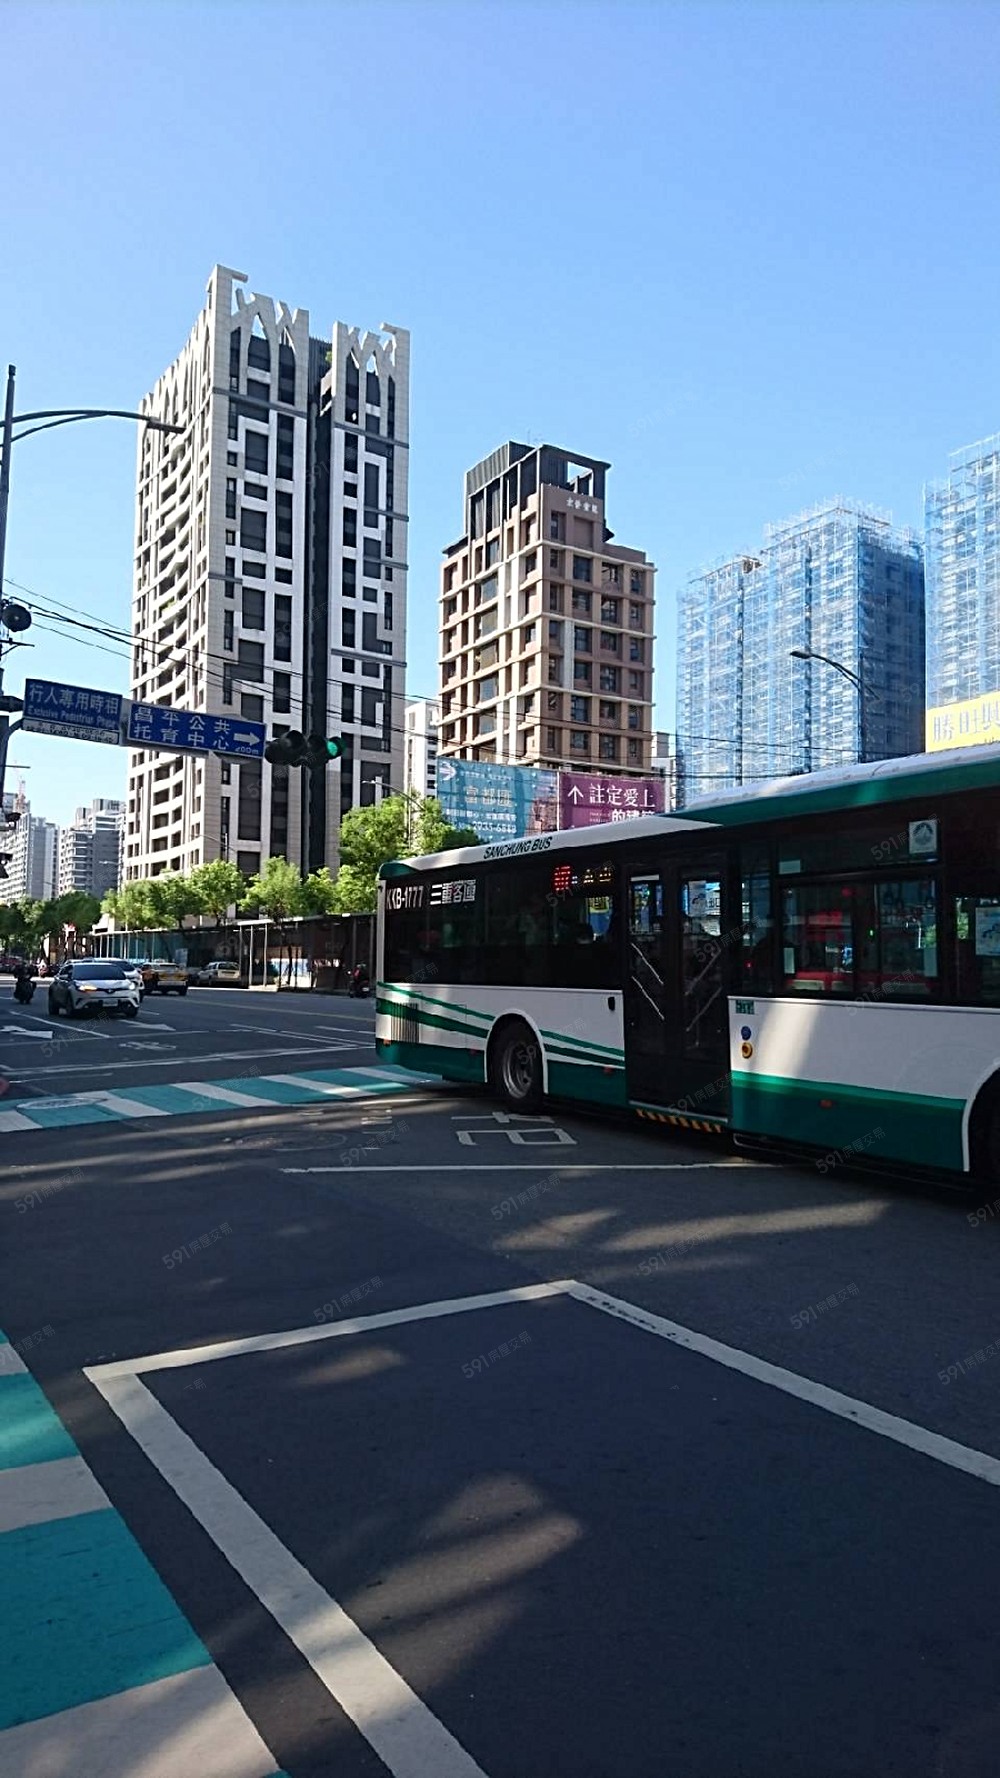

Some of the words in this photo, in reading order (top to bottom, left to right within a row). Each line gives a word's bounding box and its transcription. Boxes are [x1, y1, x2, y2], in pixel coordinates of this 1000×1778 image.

[29, 683, 119, 714] 行人專用時相
[134, 707, 231, 735] 昌平公共
[133, 723, 229, 750] 托育中心
[589, 782, 655, 808] 註定愛上
[483, 840, 531, 860] SANCHUNG
[532, 836, 553, 851] BUS
[386, 885, 425, 910] KKB-1777
[429, 879, 476, 905] 三重客運
